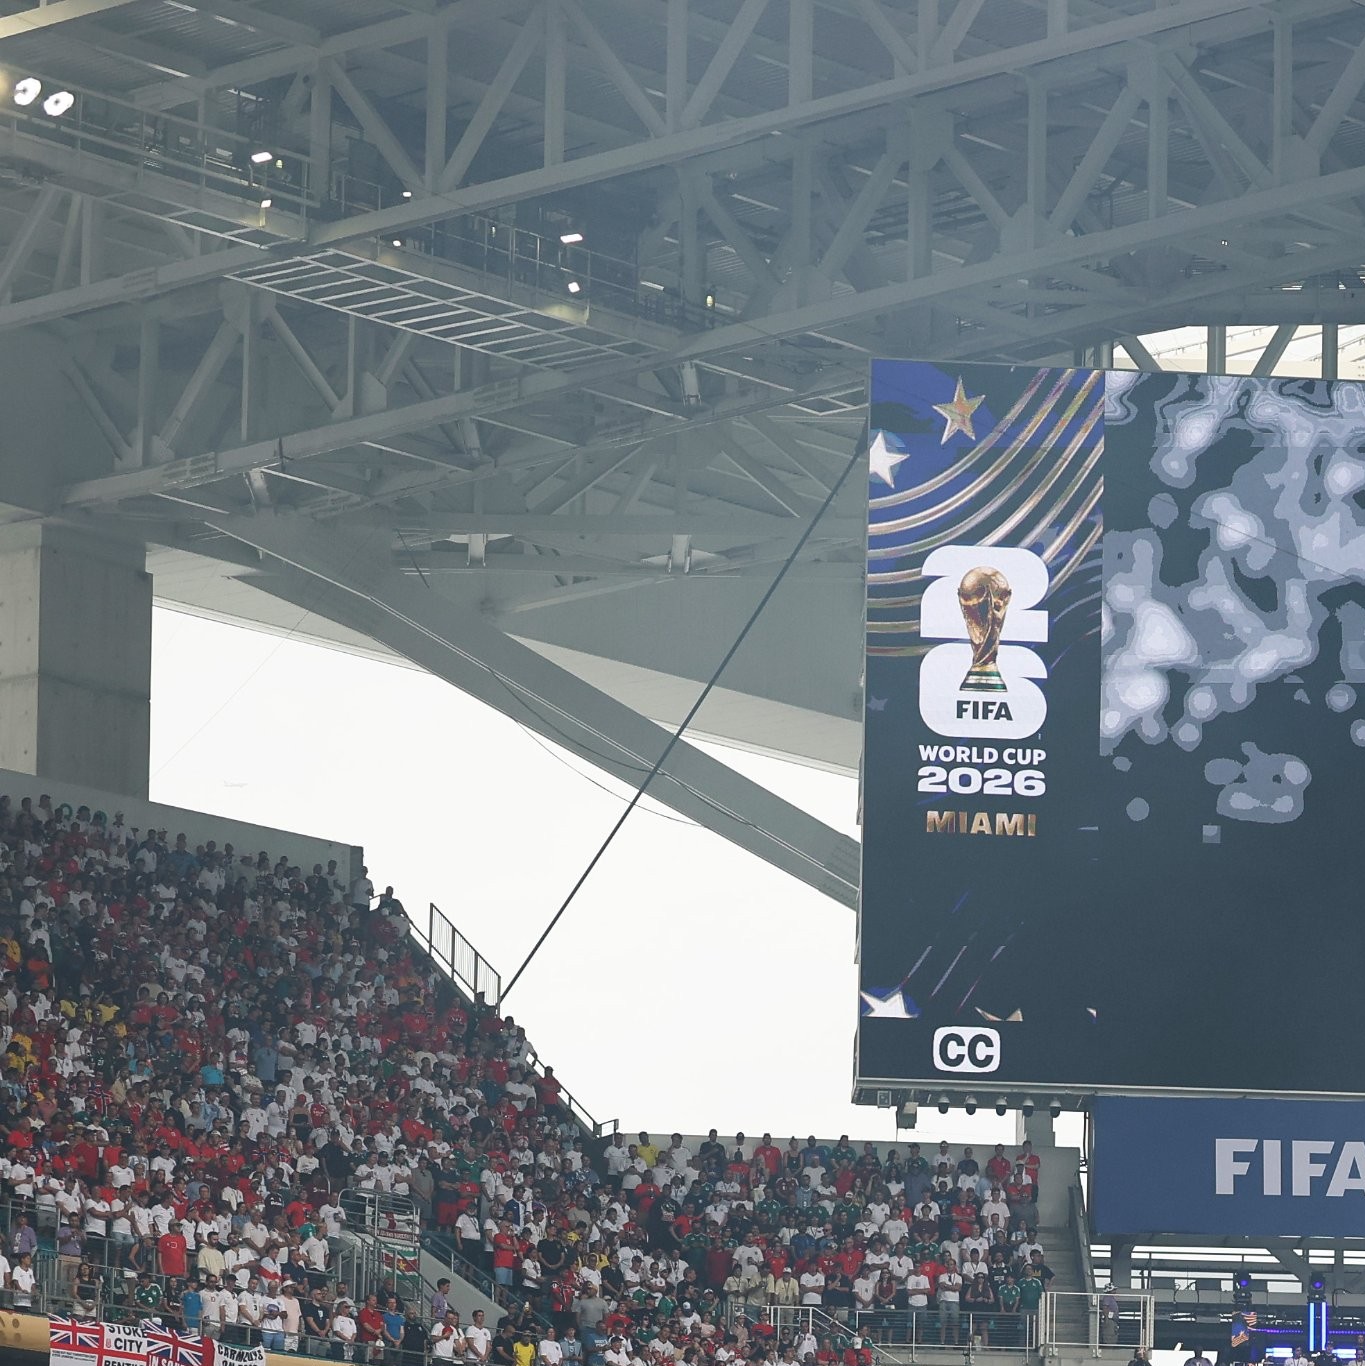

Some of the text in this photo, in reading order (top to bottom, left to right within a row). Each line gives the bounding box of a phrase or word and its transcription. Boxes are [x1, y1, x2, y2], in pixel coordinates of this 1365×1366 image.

[956, 700, 1013, 722] FIFA
[919, 745, 1046, 766] WORLD CUP
[918, 768, 1046, 796] 2026
[926, 810, 1037, 837] MIAMI
[938, 1033, 995, 1067] CC
[114, 1338, 142, 1352] CITY
